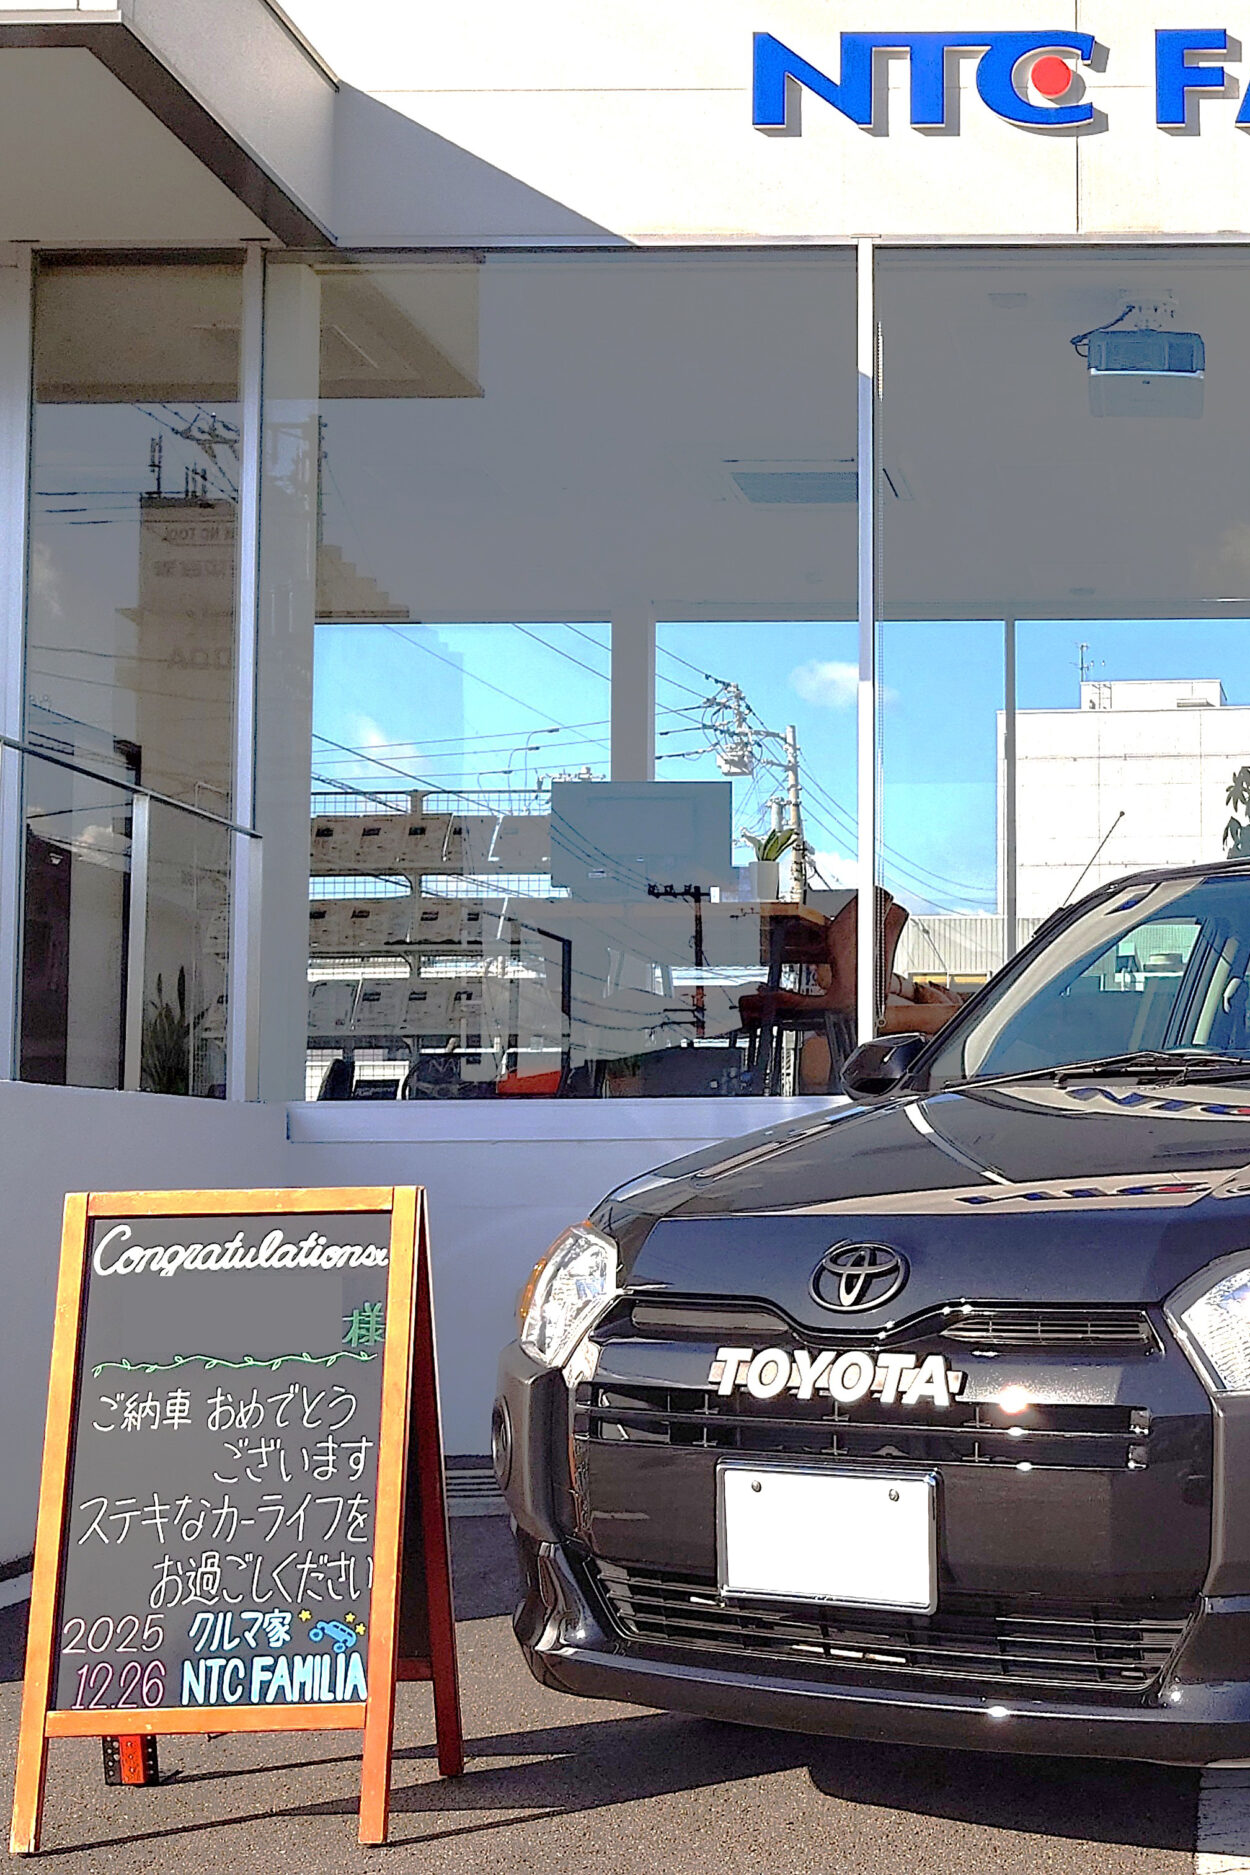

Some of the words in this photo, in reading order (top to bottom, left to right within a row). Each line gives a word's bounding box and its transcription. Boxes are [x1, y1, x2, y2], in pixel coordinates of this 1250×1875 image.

[753, 31, 1095, 127] NTC
[341, 1301, 385, 1348] 様
[716, 1347, 952, 1407] TOYOTA
[92, 1387, 193, 1432] ご納車
[206, 1383, 358, 1431] おめでとう
[213, 1434, 374, 1483] ございます
[77, 1492, 370, 1545] ステキなカーライフを
[149, 1551, 374, 1608] お過ごしください
[61, 1613, 165, 1655] 2025
[188, 1607, 293, 1652] クルマ家
[71, 1659, 167, 1711] 12.26
[181, 1656, 247, 1706] NTC
[250, 1651, 369, 1704] FAMILIA
